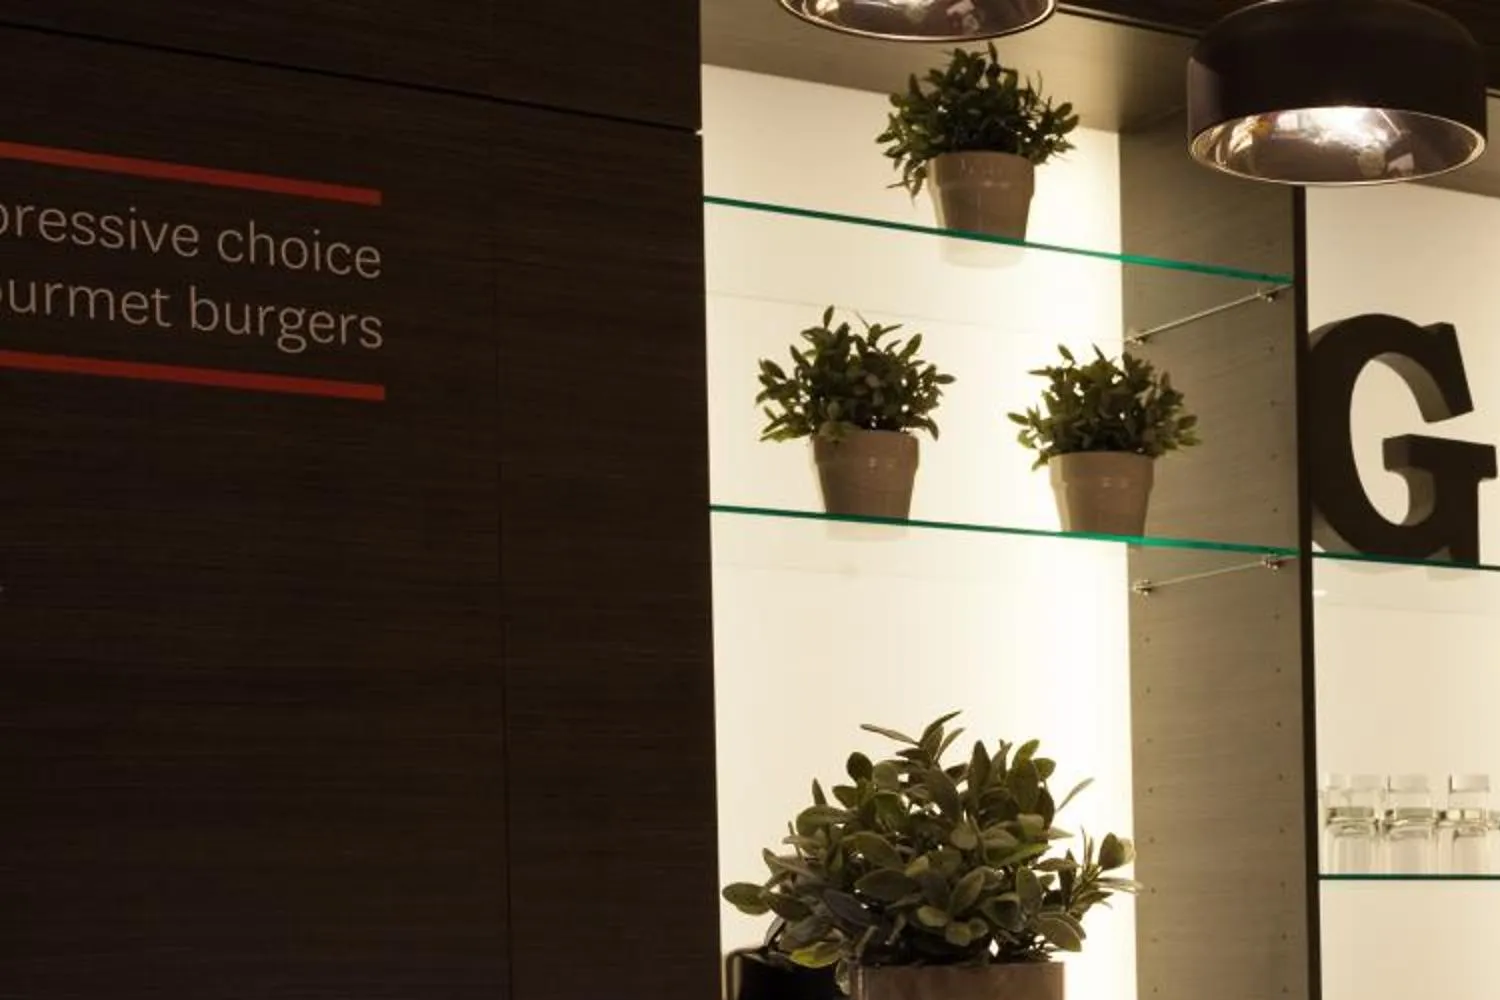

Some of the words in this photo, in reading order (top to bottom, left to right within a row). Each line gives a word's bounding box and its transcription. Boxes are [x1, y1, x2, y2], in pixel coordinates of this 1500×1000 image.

[217, 219, 382, 279] choice
[0, 278, 171, 328] urmet
[189, 284, 384, 354] burgers
[1307, 313, 1498, 566] G
